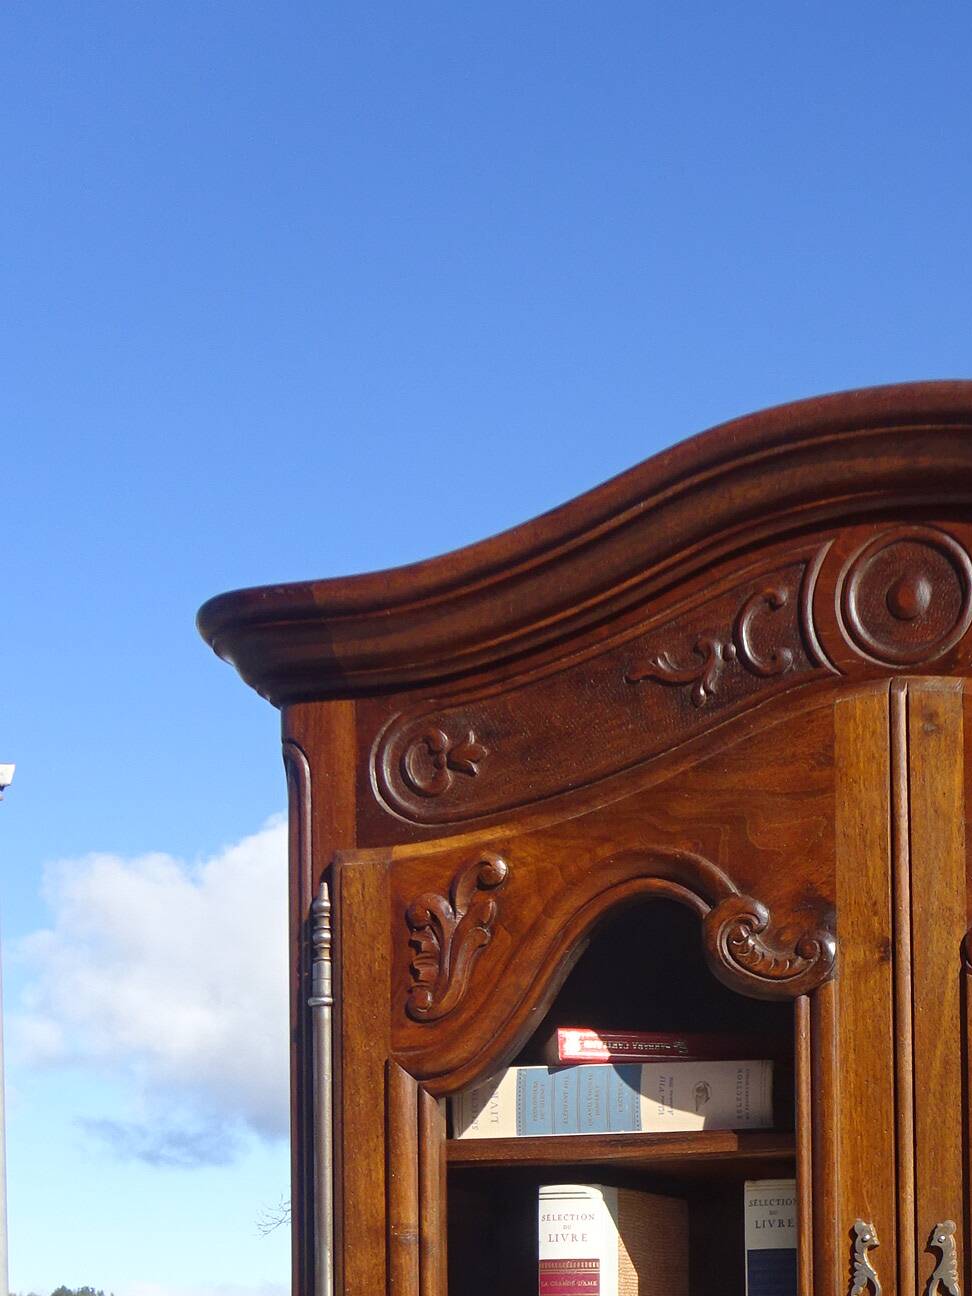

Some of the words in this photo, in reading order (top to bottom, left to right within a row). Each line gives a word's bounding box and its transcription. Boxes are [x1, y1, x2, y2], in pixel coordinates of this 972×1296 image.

[541, 1213, 596, 1222] SÉLECTION
[755, 1218, 795, 1229] LIVRE
[547, 1233, 588, 1243] LIVRE
